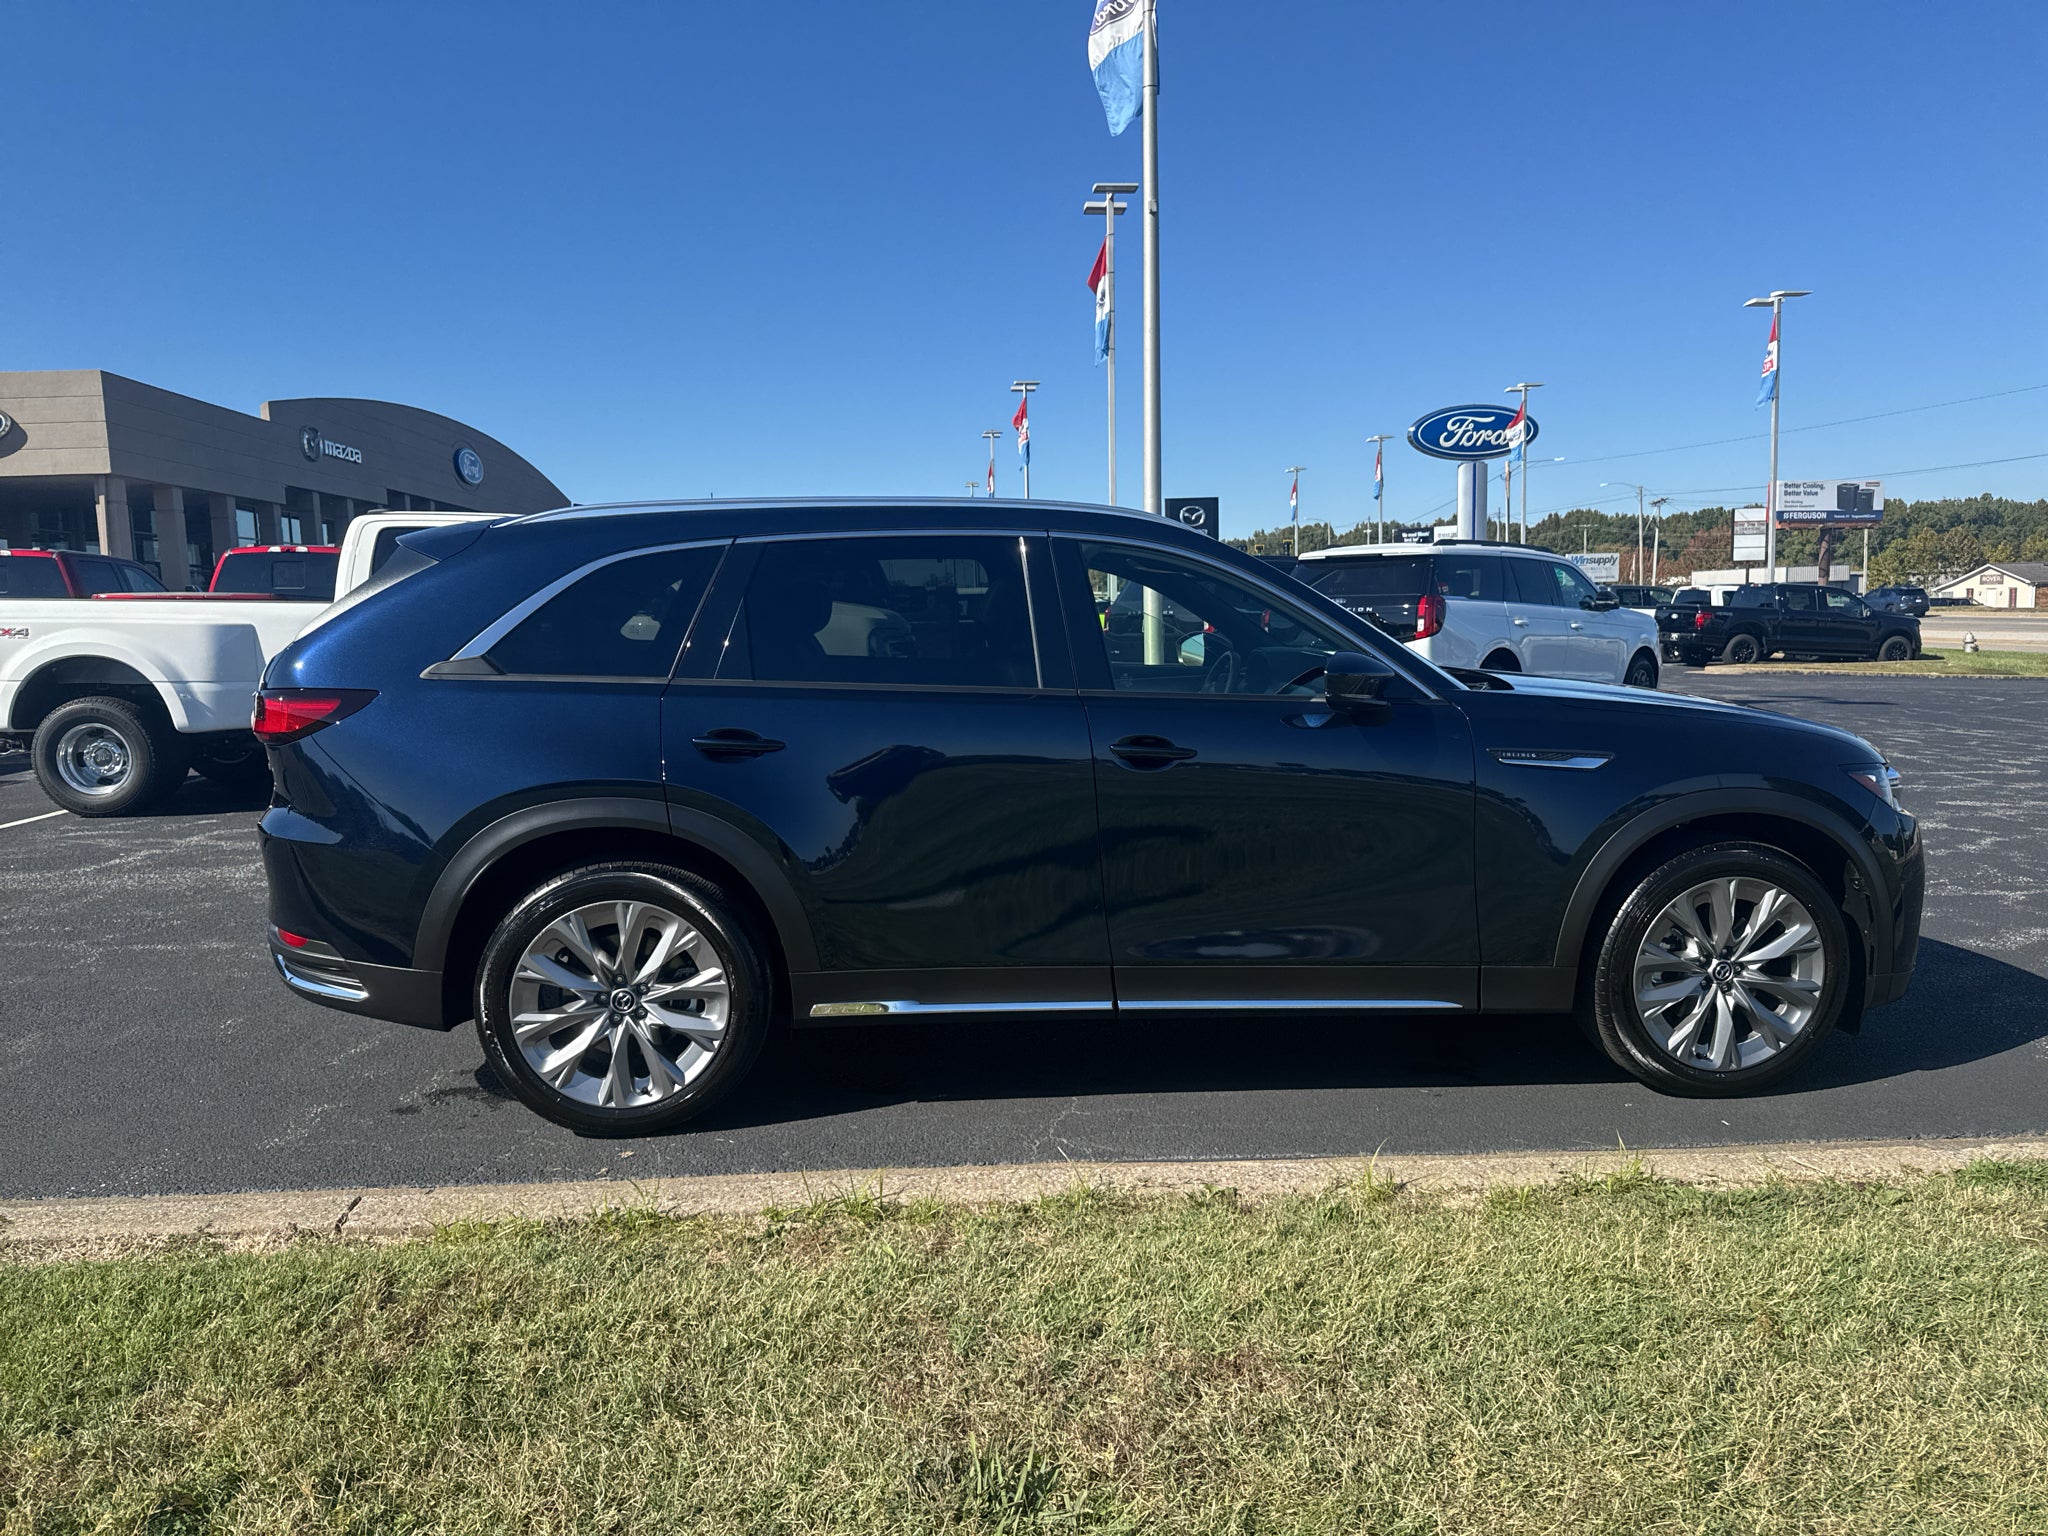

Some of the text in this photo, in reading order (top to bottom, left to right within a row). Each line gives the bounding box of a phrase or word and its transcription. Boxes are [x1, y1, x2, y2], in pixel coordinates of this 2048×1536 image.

[463, 454, 482, 478] Ford
[1802, 482, 1826, 490] Cooling,
[1571, 554, 1618, 566] Winsupply
